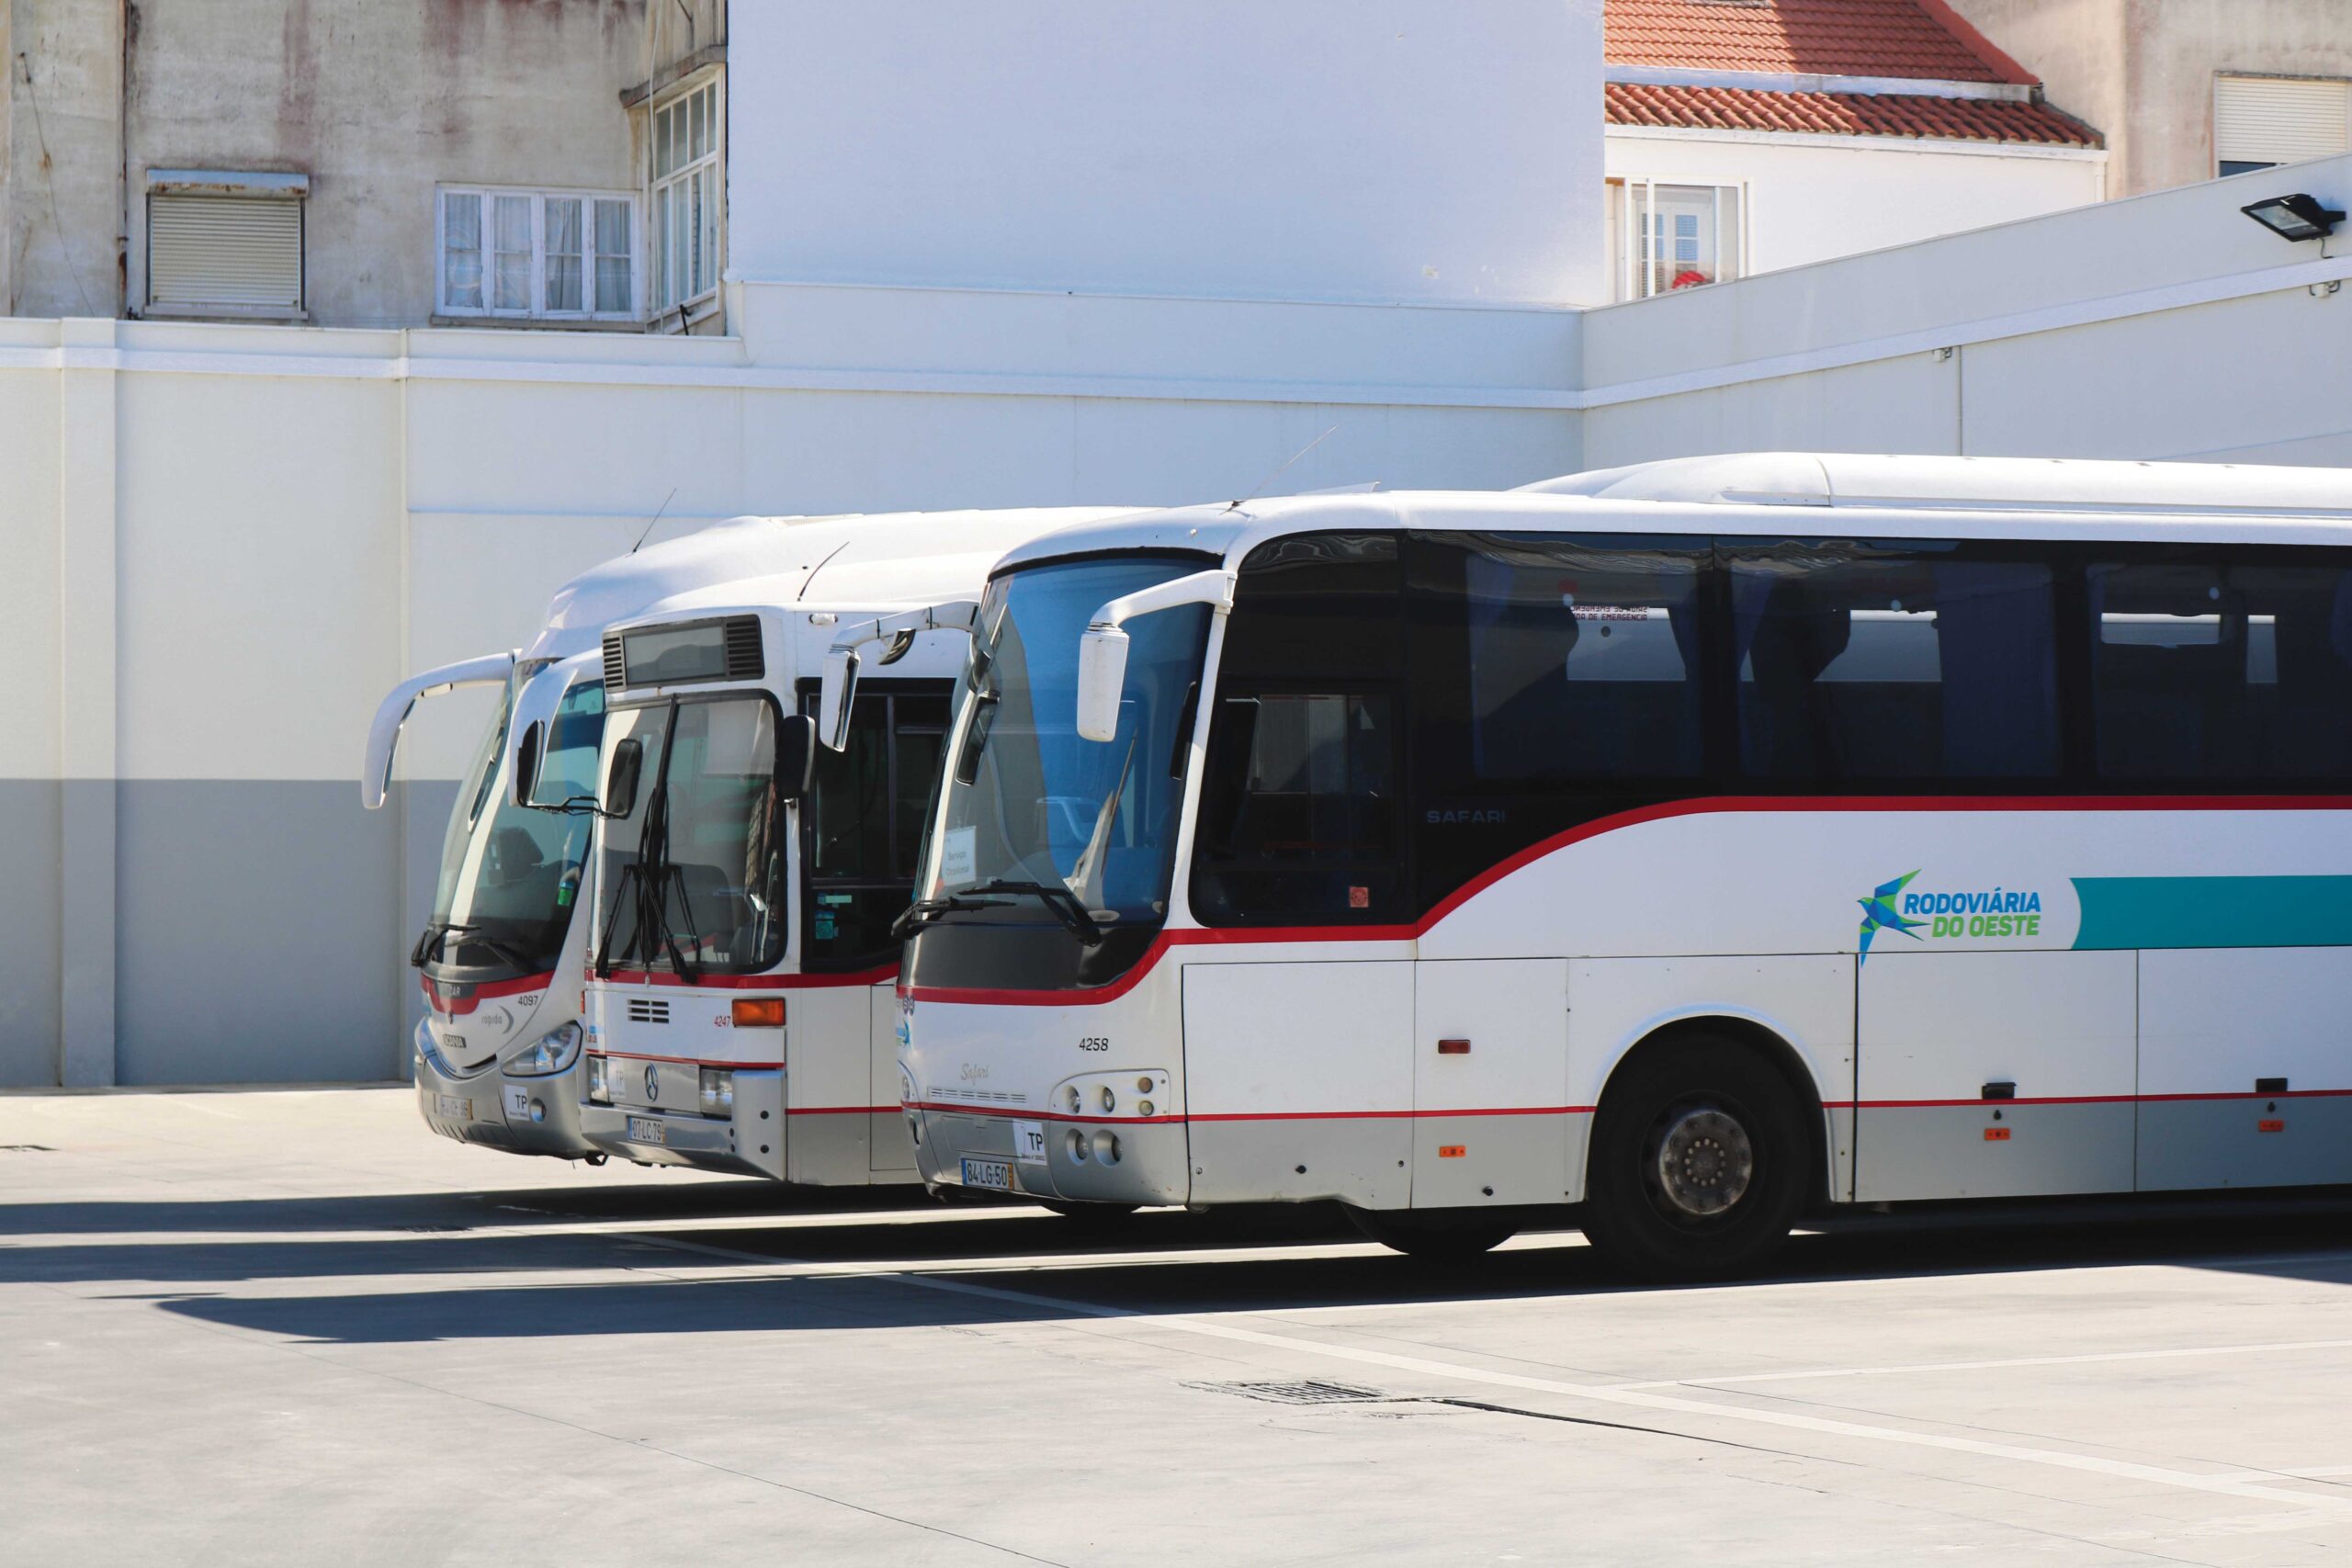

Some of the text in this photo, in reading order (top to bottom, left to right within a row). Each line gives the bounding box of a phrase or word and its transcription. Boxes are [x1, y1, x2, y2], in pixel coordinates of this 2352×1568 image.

[1589, 613, 1598, 621] DE
[1426, 810, 1506, 823] SAFARI
[1904, 886, 2041, 915] RODOVIÁRIA
[1932, 914, 2041, 938] DO OESTE
[517, 995, 538, 1007] 4097
[714, 1015, 731, 1027] 4247
[1079, 1037, 1109, 1052] 4258
[616, 1070, 624, 1087] TP
[960, 1063, 989, 1086] Safari
[514, 1094, 527, 1110] TP
[1027, 1132, 1043, 1151] TP
